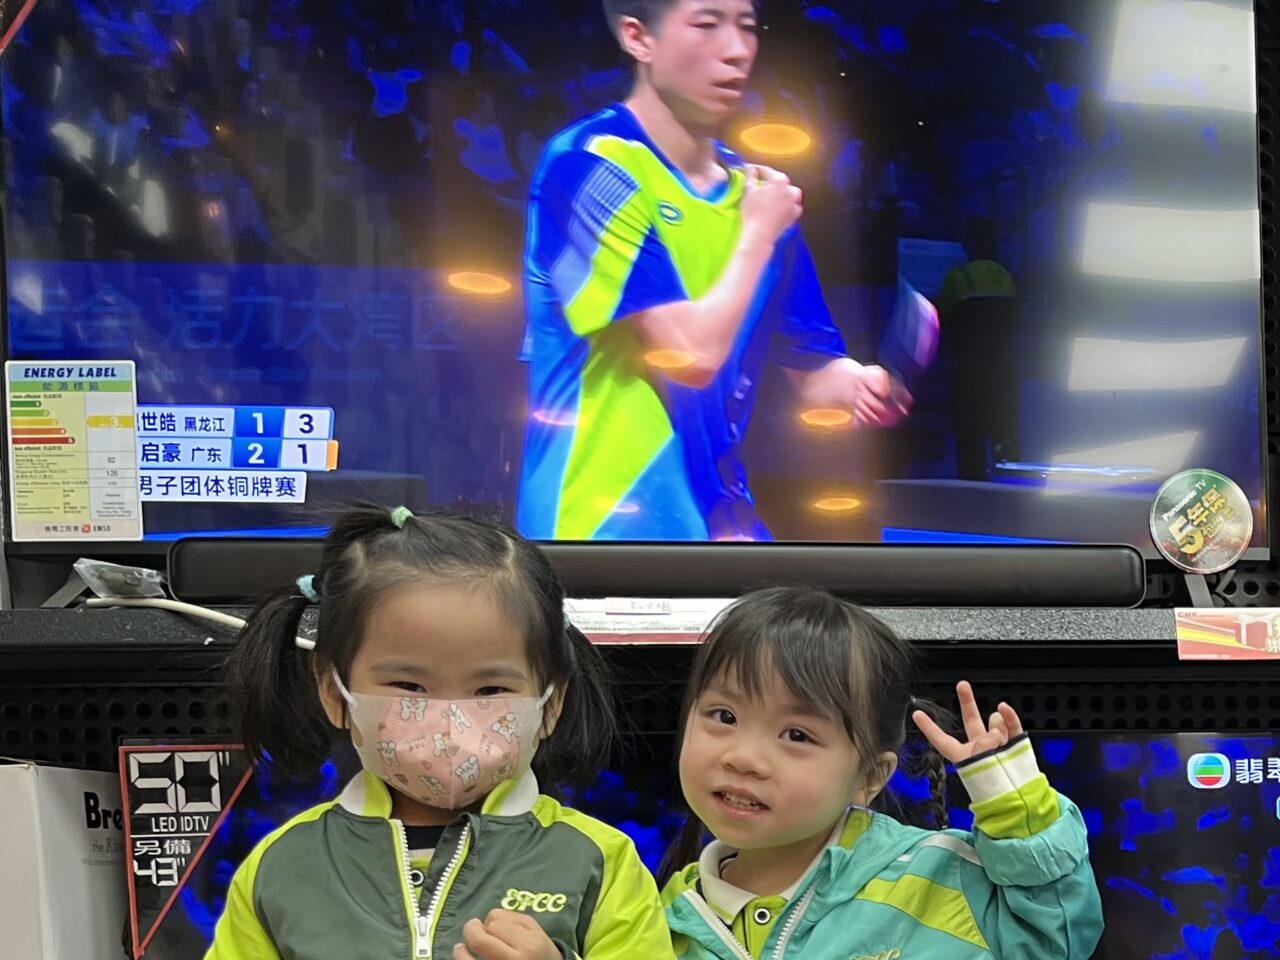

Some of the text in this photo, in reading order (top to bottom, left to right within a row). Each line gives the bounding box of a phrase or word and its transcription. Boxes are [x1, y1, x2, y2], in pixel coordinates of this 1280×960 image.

[24, 366, 117, 378] ENERGY LABEL
[110, 416, 119, 427] 3
[136, 411, 315, 434] 世皓 黑龙江 1 3
[191, 446, 223, 463] 广东
[247, 442, 265, 464] 2
[297, 443, 308, 464] 1
[140, 475, 297, 498] 男子团体铜牌赛
[1161, 489, 1198, 522] Panasonic
[1194, 478, 1207, 491] TV
[151, 815, 209, 833] LED IDTV
